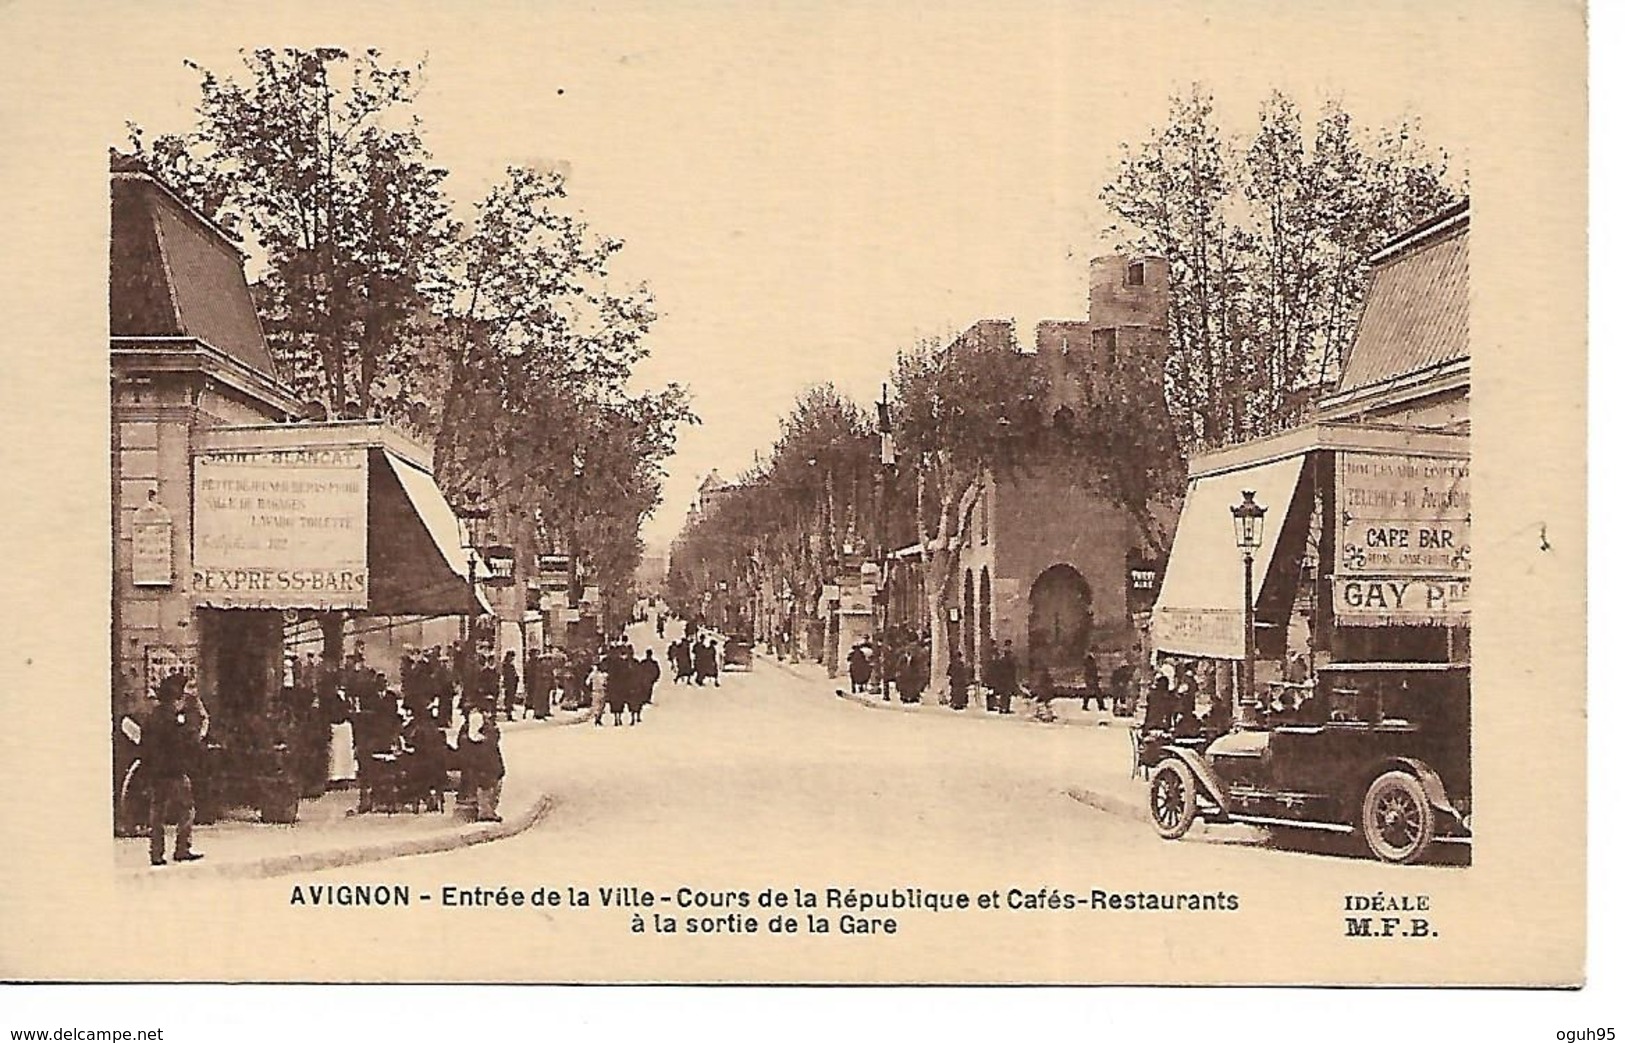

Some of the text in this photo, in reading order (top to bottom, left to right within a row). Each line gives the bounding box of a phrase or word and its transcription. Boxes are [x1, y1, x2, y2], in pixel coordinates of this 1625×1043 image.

[1366, 528, 1455, 549] CAFE BAR
[1344, 582, 1409, 609] GAY
